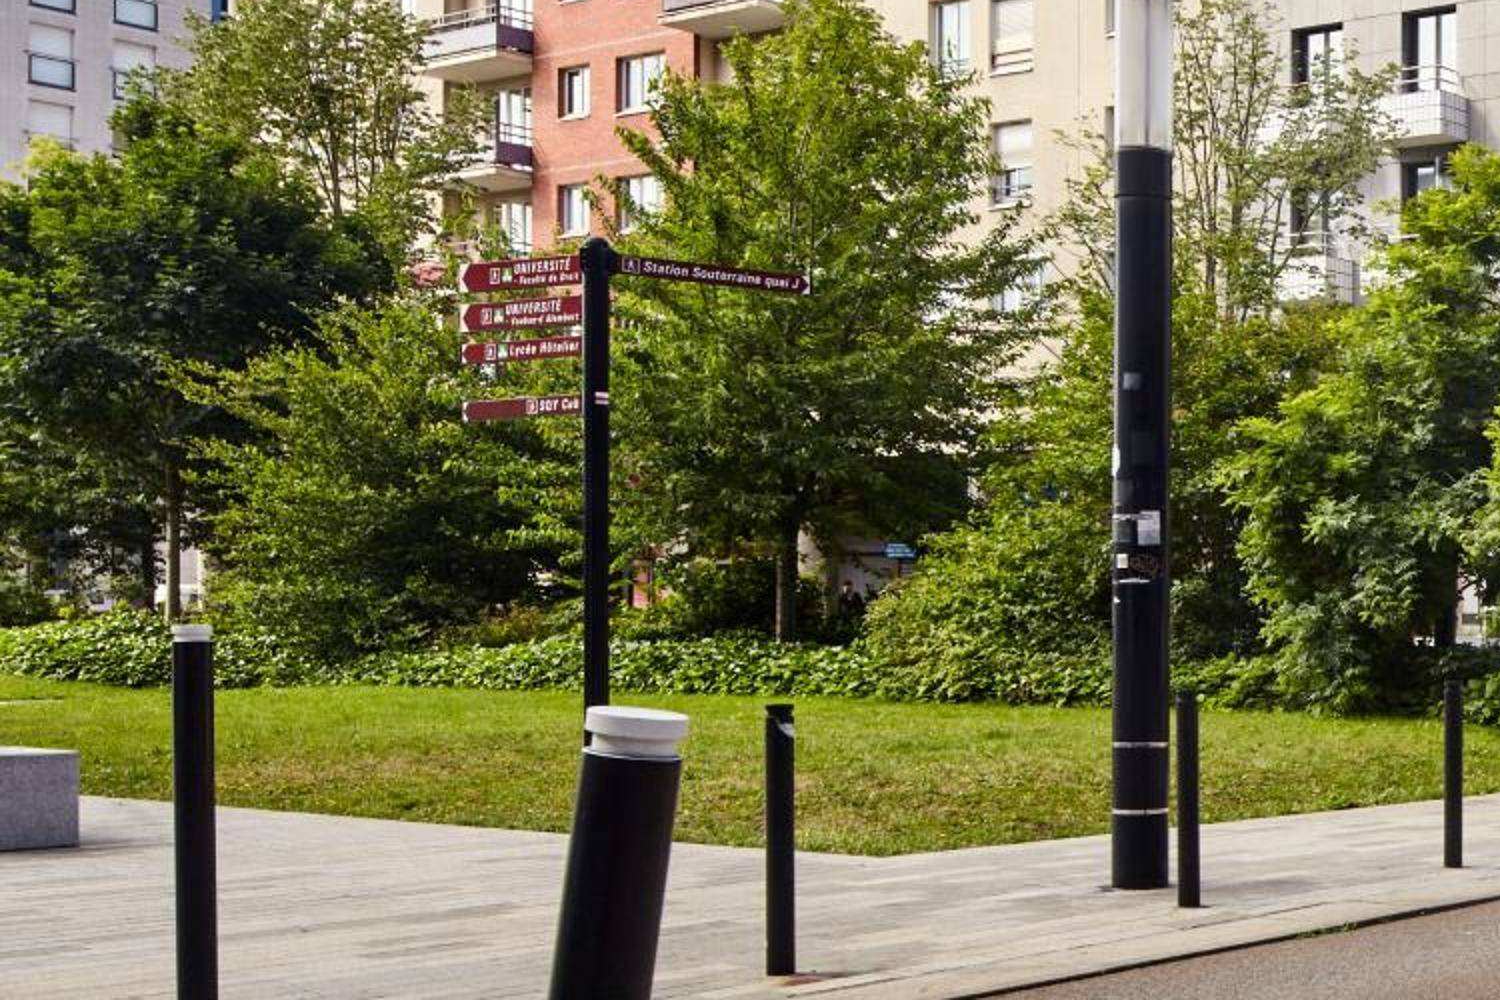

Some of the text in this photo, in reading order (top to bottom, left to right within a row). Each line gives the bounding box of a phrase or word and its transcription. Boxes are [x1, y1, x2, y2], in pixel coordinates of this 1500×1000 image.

[513, 258, 571, 274] UNIVERSITÉ
[643, 261, 799, 289] Station Souterraine quai J
[505, 300, 561, 315] UNIVERSITÉ
